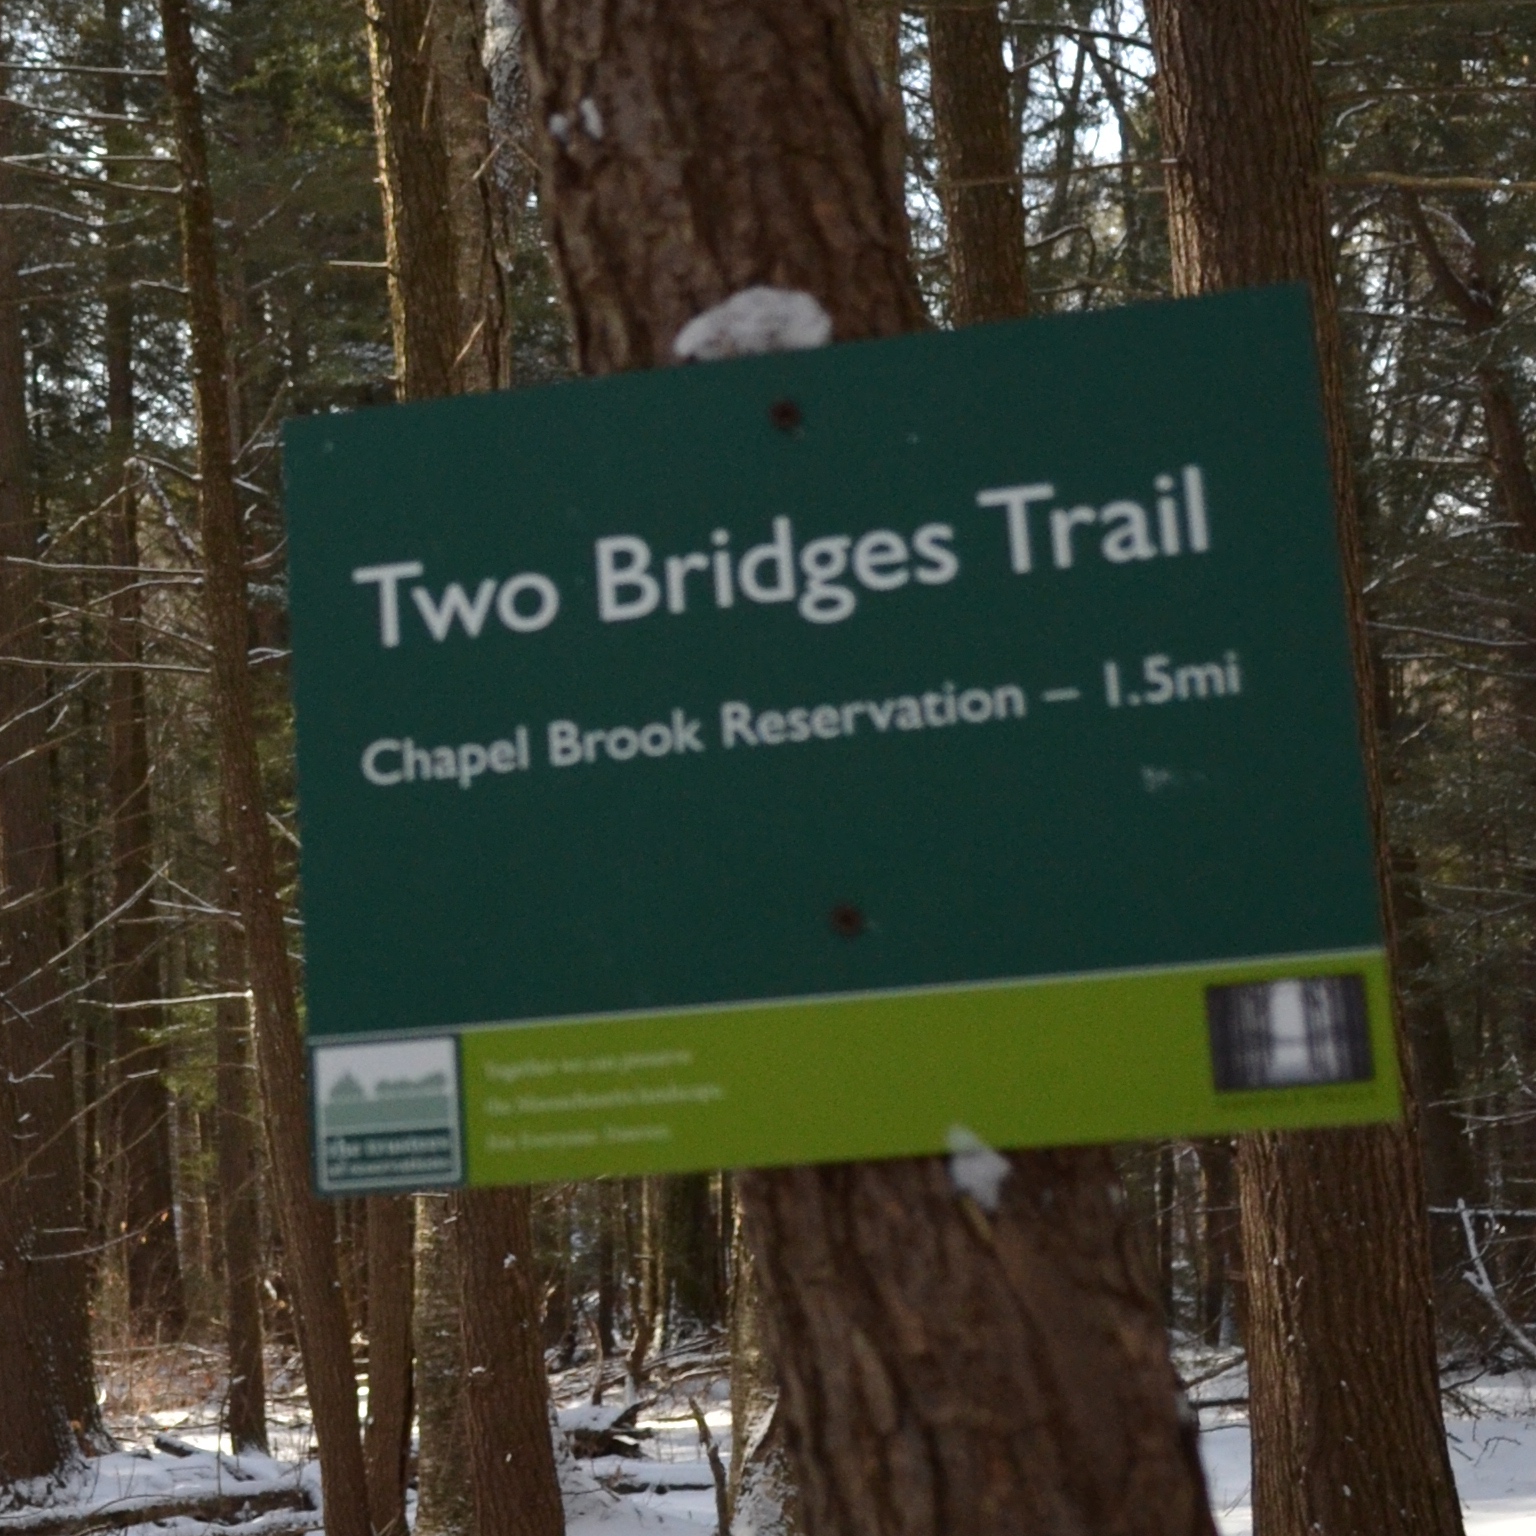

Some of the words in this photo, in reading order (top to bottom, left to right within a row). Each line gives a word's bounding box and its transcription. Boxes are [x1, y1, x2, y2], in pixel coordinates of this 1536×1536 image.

[352, 561, 559, 648] Two
[595, 516, 960, 625] Bridges
[976, 465, 1211, 575] Trail
[360, 725, 531, 789] Chapel
[546, 707, 705, 768] Brook
[719, 682, 1027, 748] Reservation
[1102, 649, 1242, 708] 1.5mi
